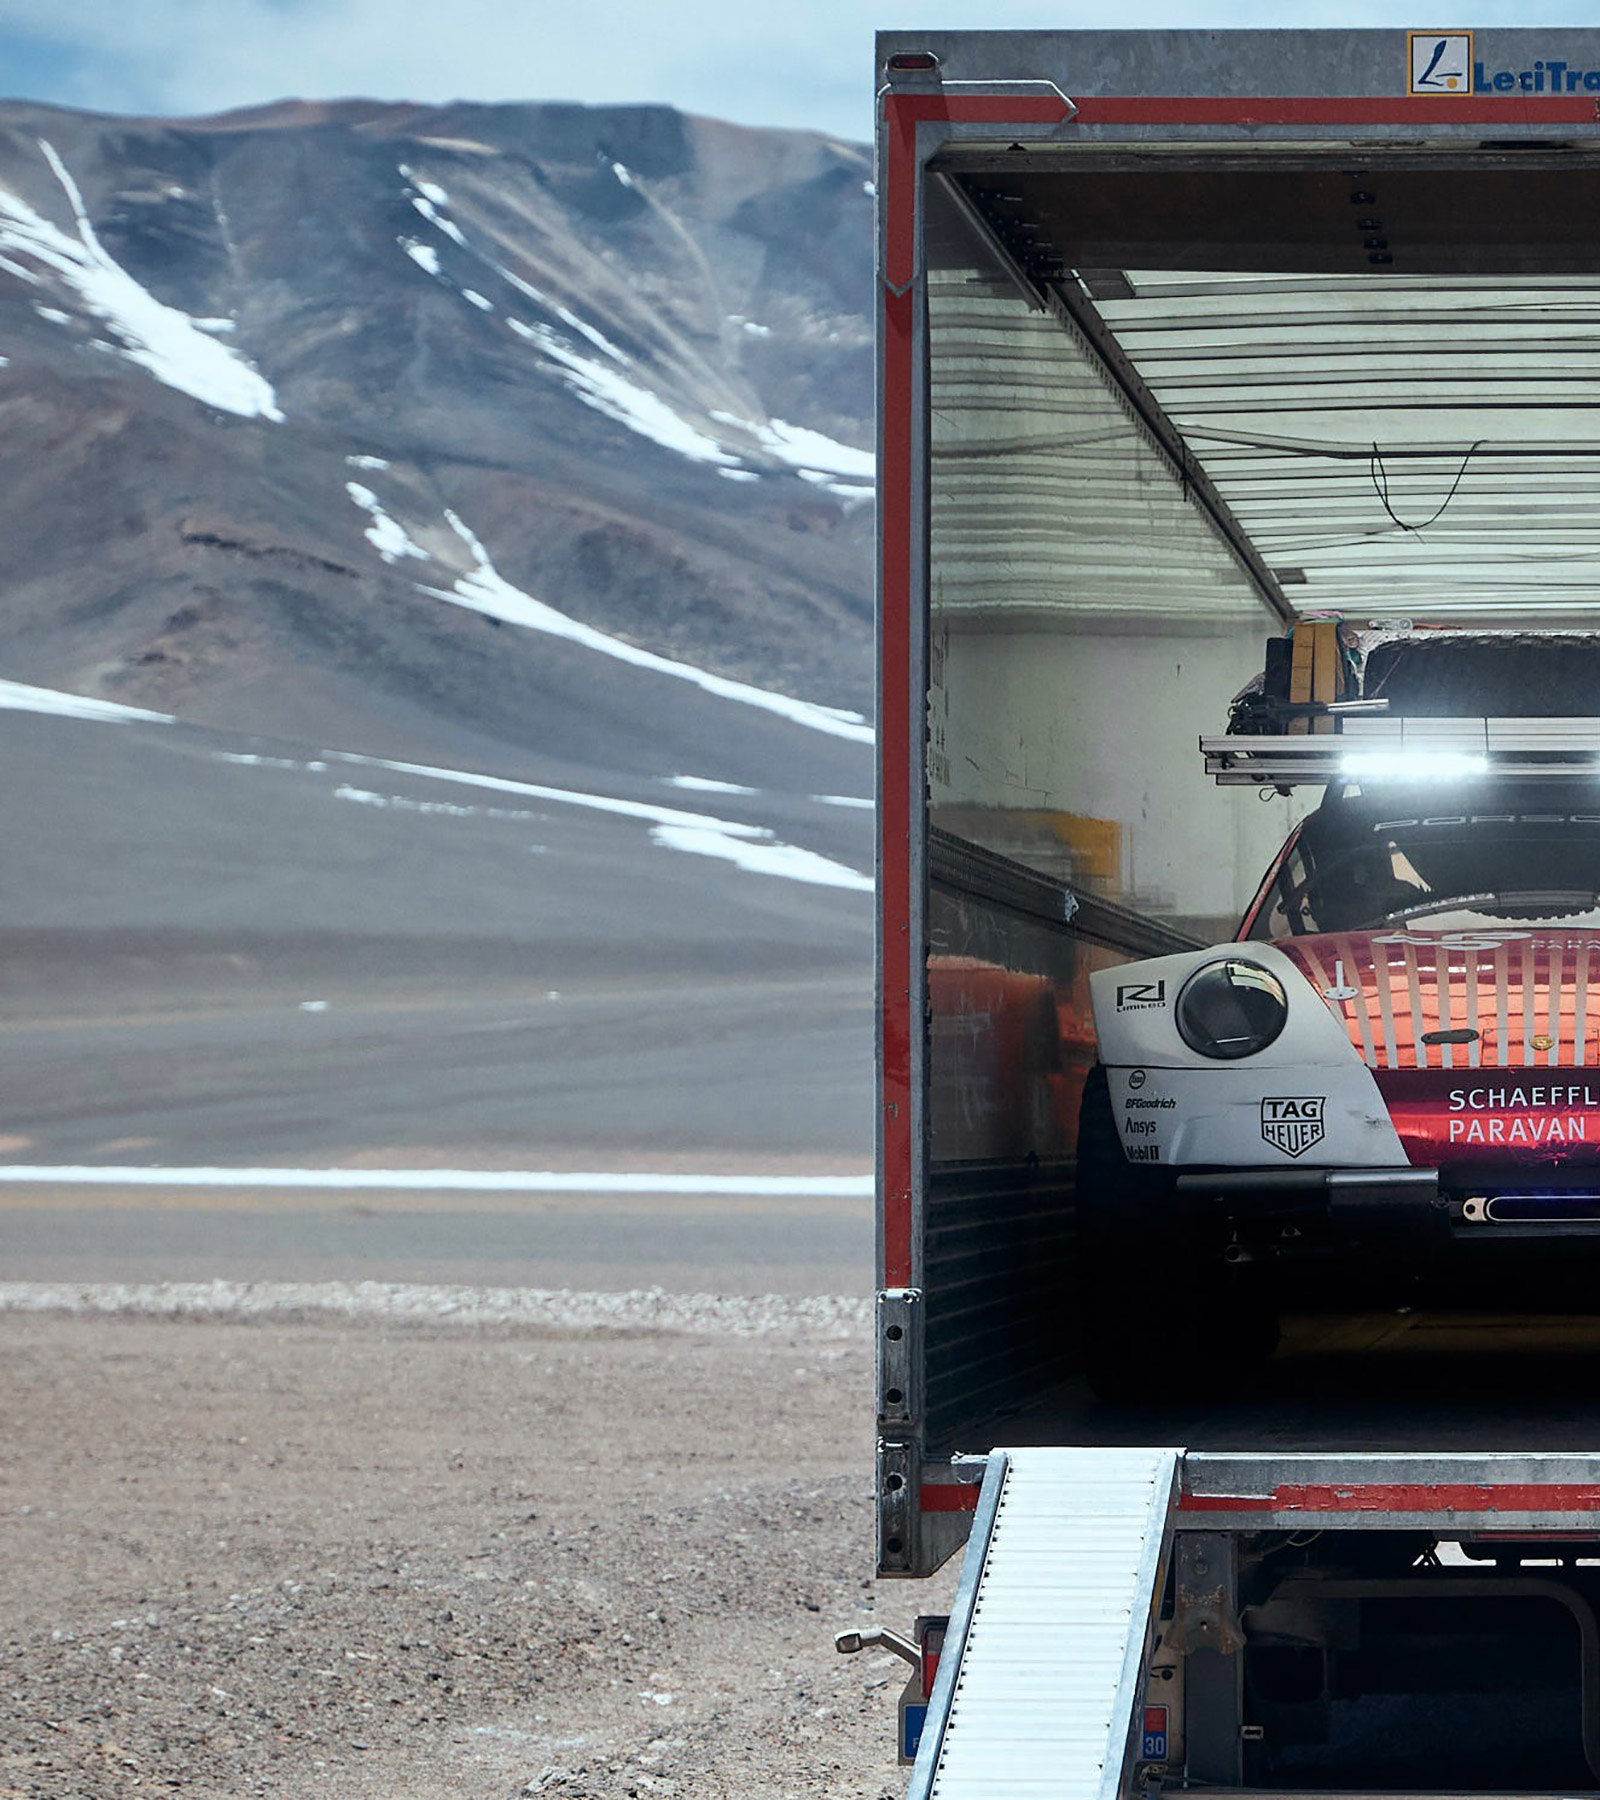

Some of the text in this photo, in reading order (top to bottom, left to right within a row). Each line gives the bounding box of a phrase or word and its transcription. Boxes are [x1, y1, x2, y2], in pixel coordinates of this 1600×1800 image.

[1125, 1098, 1177, 1109] BFGoodrich
[1267, 1100, 1318, 1119] TAG
[1125, 1116, 1157, 1137] Ansys
[1449, 1116, 1585, 1143] PARAVAN
[1265, 1125, 1321, 1153] HEUER
[1145, 1736, 1164, 1755] 30
